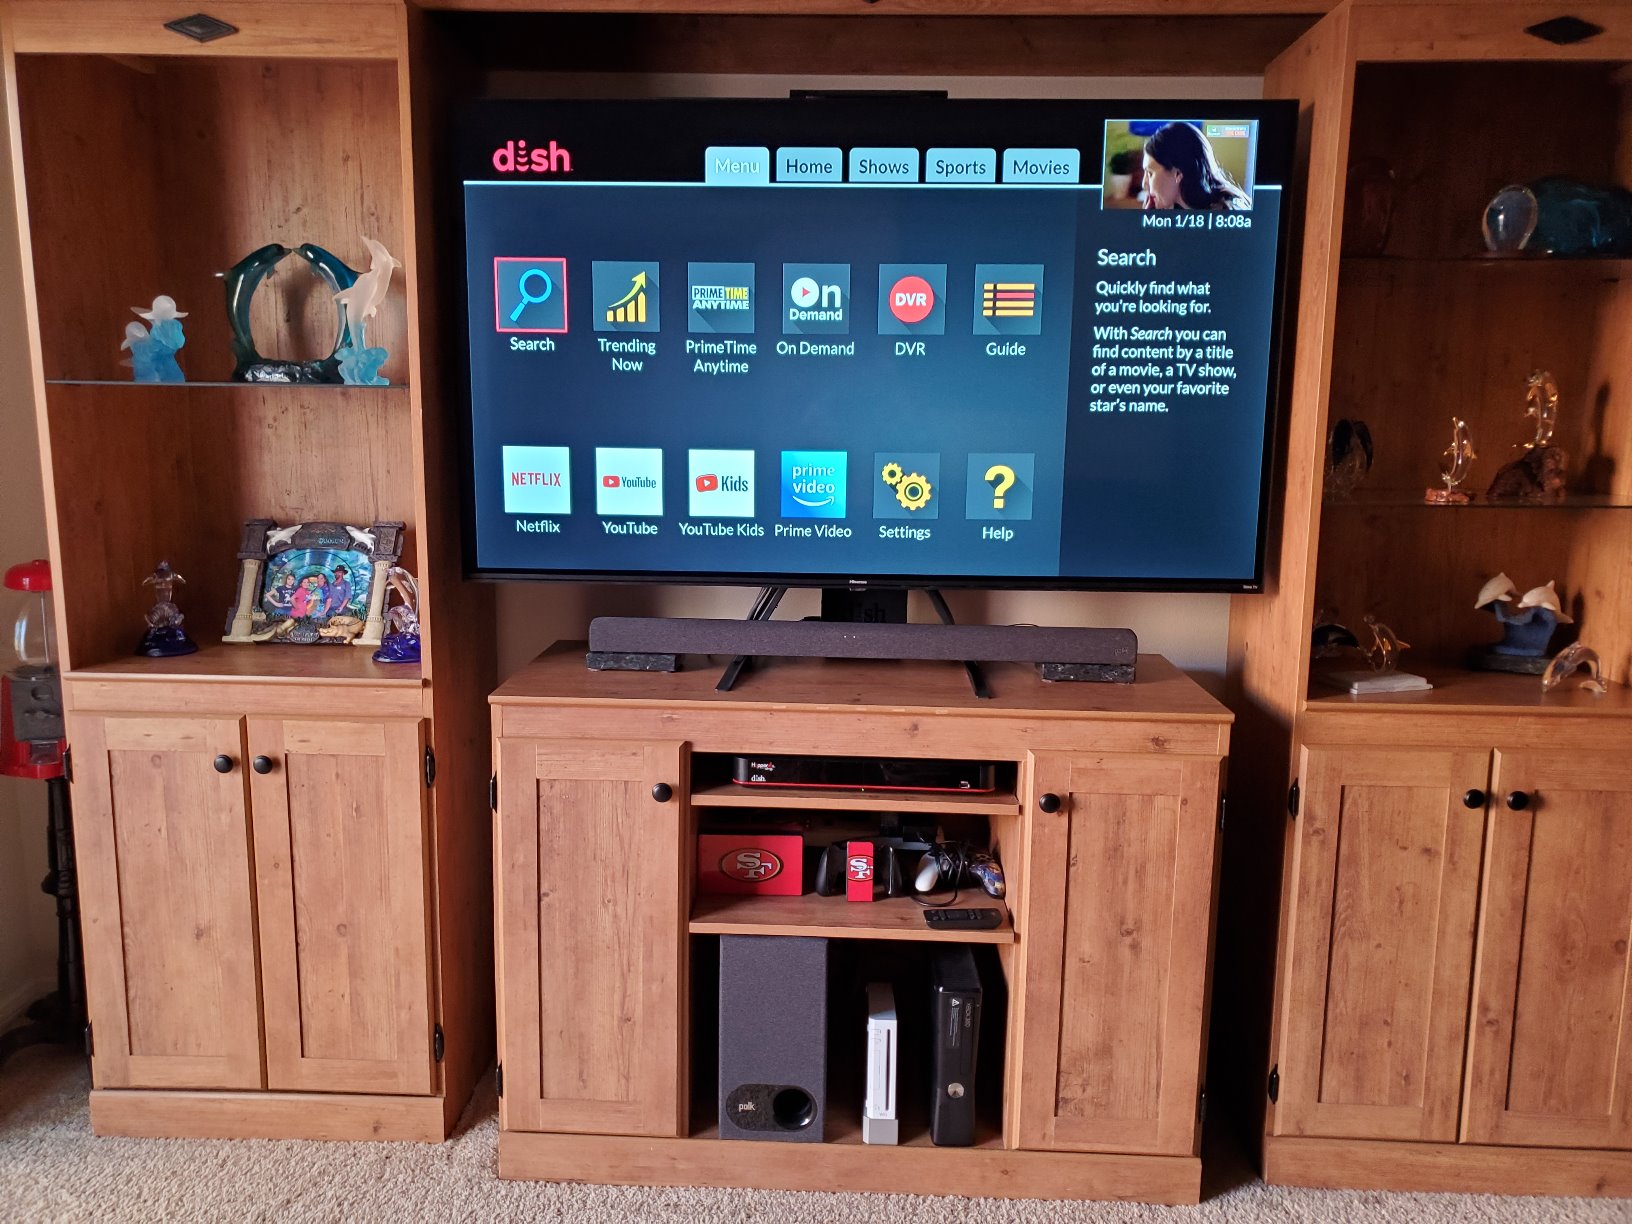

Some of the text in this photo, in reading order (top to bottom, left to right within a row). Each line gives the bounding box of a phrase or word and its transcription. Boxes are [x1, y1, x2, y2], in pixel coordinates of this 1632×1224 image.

[492, 140, 571, 172] dish
[714, 157, 760, 174] Menu
[785, 158, 833, 174] Home
[858, 159, 909, 175] Shows
[935, 159, 986, 178] Sports
[1013, 159, 1070, 175] Movies
[1142, 214, 1172, 228] Mon
[1175, 215, 1204, 228] 1/18
[1215, 215, 1252, 228] 8:08a
[1097, 248, 1157, 267] Search
[791, 277, 842, 308] On
[1096, 281, 1211, 296] Quickly find what
[692, 300, 750, 310] ANYTIME
[895, 292, 927, 307] DVR
[789, 309, 843, 321] Demand
[1095, 300, 1212, 316] you're looking for.
[1093, 326, 1227, 343] With Search you can
[510, 337, 555, 351] Search
[598, 339, 656, 355] Trending
[686, 340, 757, 354] PrimeTime
[776, 341, 855, 356] On Demand
[895, 342, 926, 356] DVR
[986, 342, 1026, 356] Guide
[1092, 344, 1234, 361] find content by a title
[612, 358, 643, 371] Now
[694, 359, 749, 374] Anytime
[1091, 363, 1237, 379] of a movie, a TV show,
[1090, 381, 1230, 397] or even your favorite
[1089, 399, 1169, 413] star's name.
[792, 465, 836, 478] prime
[511, 472, 561, 487] NETFLIX
[621, 476, 657, 489] YouTube
[721, 475, 749, 492] Kids
[792, 480, 836, 494] video
[516, 519, 561, 534] Netflix
[602, 521, 658, 535] YouTube
[679, 522, 765, 537] YouTube Kids
[774, 524, 852, 538] Prime Video
[879, 526, 931, 540] Settings
[982, 526, 1014, 542] Help
[738, 1102, 755, 1112] polk
